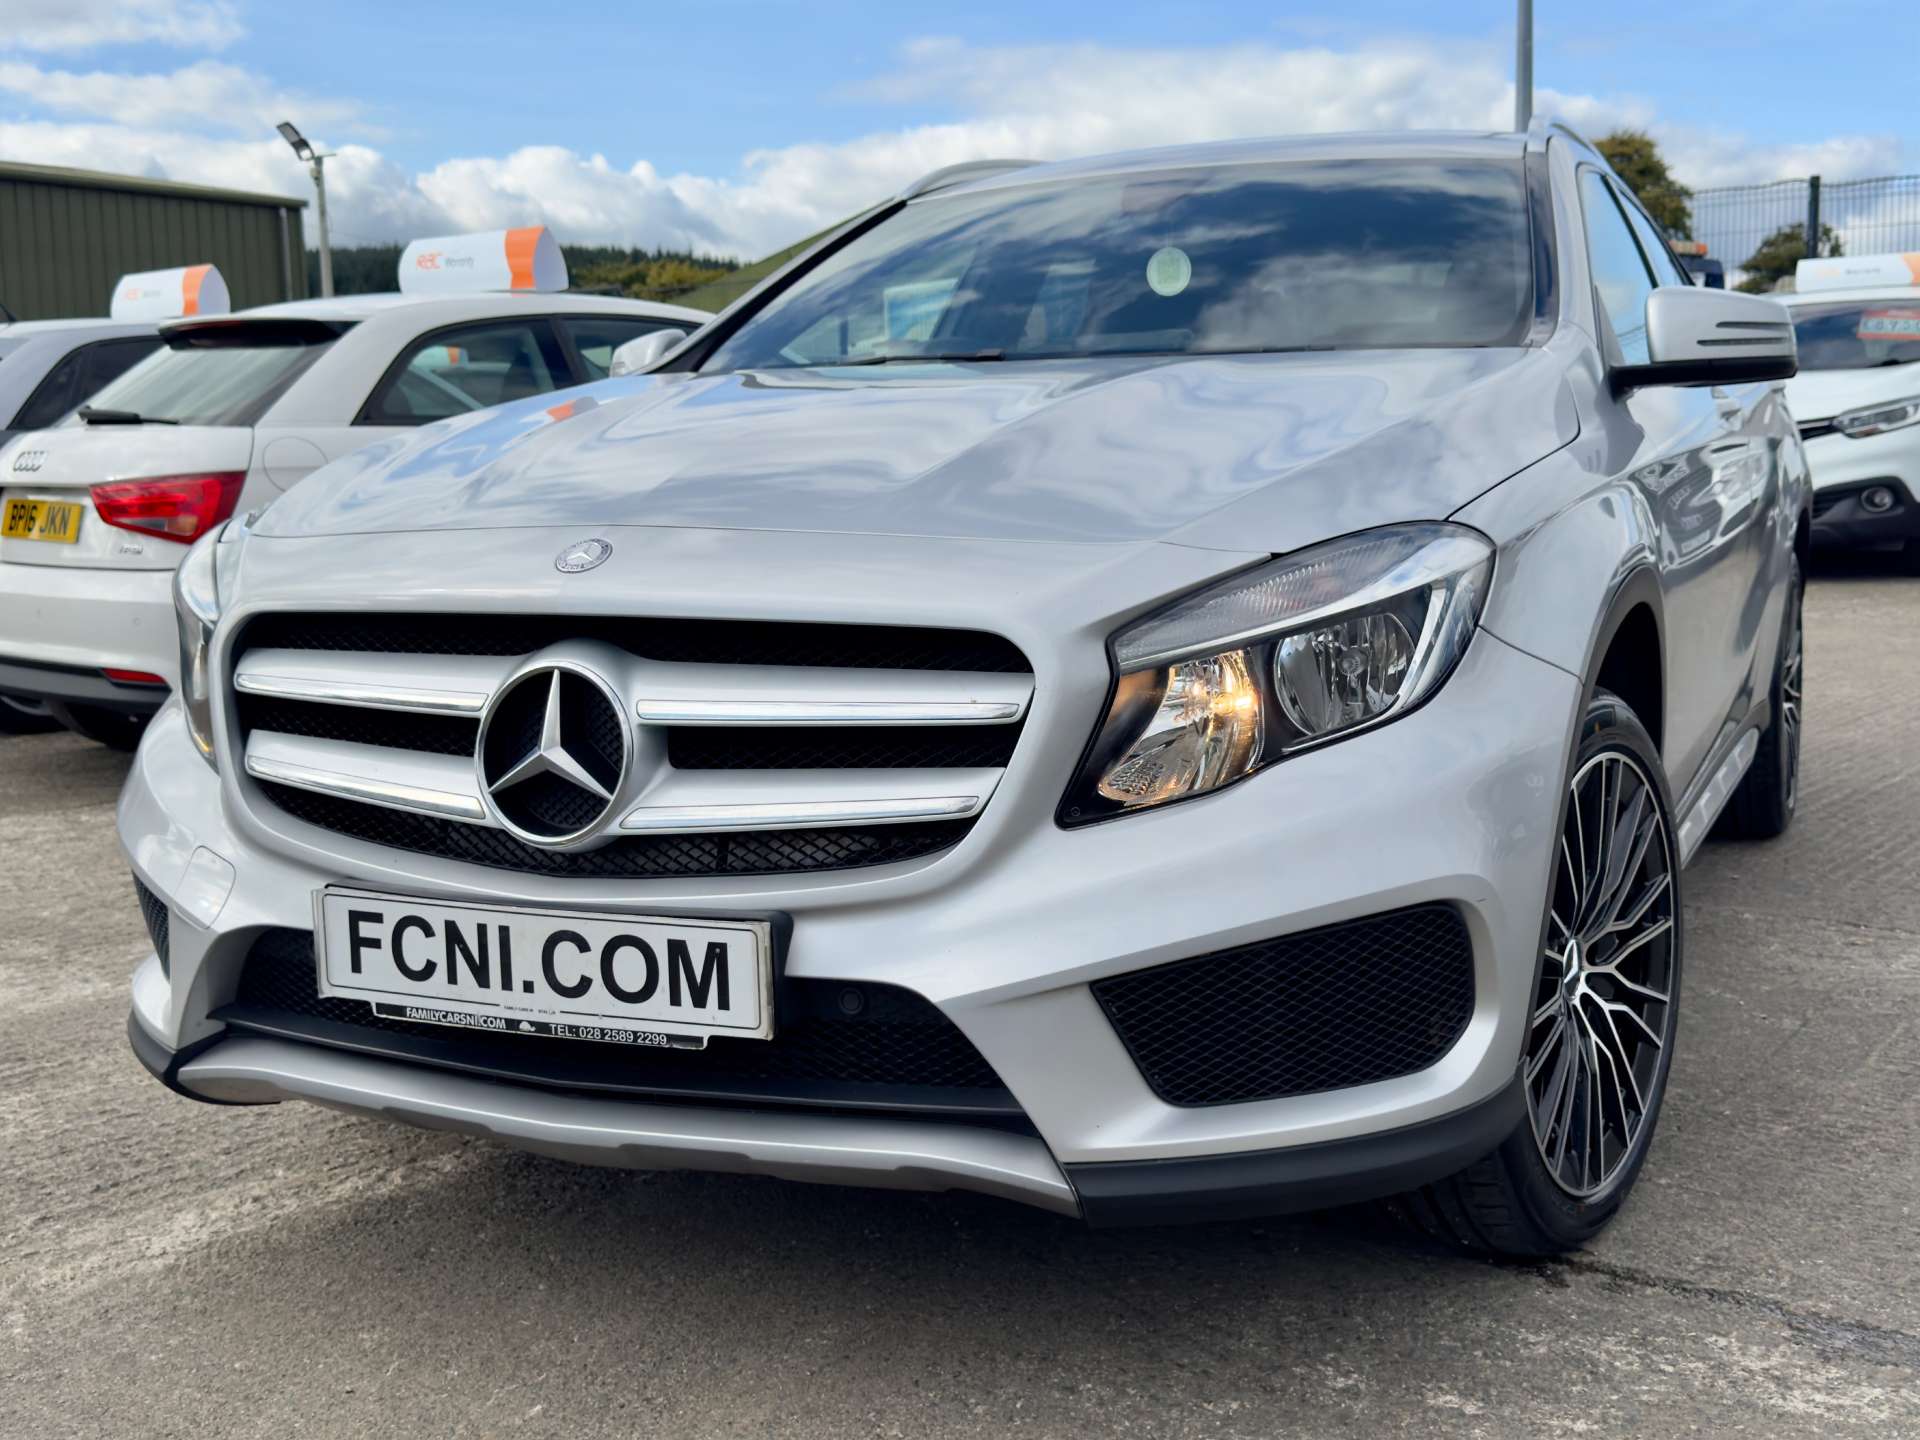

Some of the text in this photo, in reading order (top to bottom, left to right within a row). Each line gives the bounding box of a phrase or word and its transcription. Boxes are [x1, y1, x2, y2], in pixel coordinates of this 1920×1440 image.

[9, 504, 71, 536] BP16 JKN
[348, 909, 731, 1011] FCNI.COM
[406, 1006, 506, 1030] FAMILYCARSNI.COM
[549, 1023, 577, 1037] TEL:
[579, 1027, 601, 1040] 028
[604, 1029, 634, 1042] 2589
[637, 1032, 667, 1045] 2299
